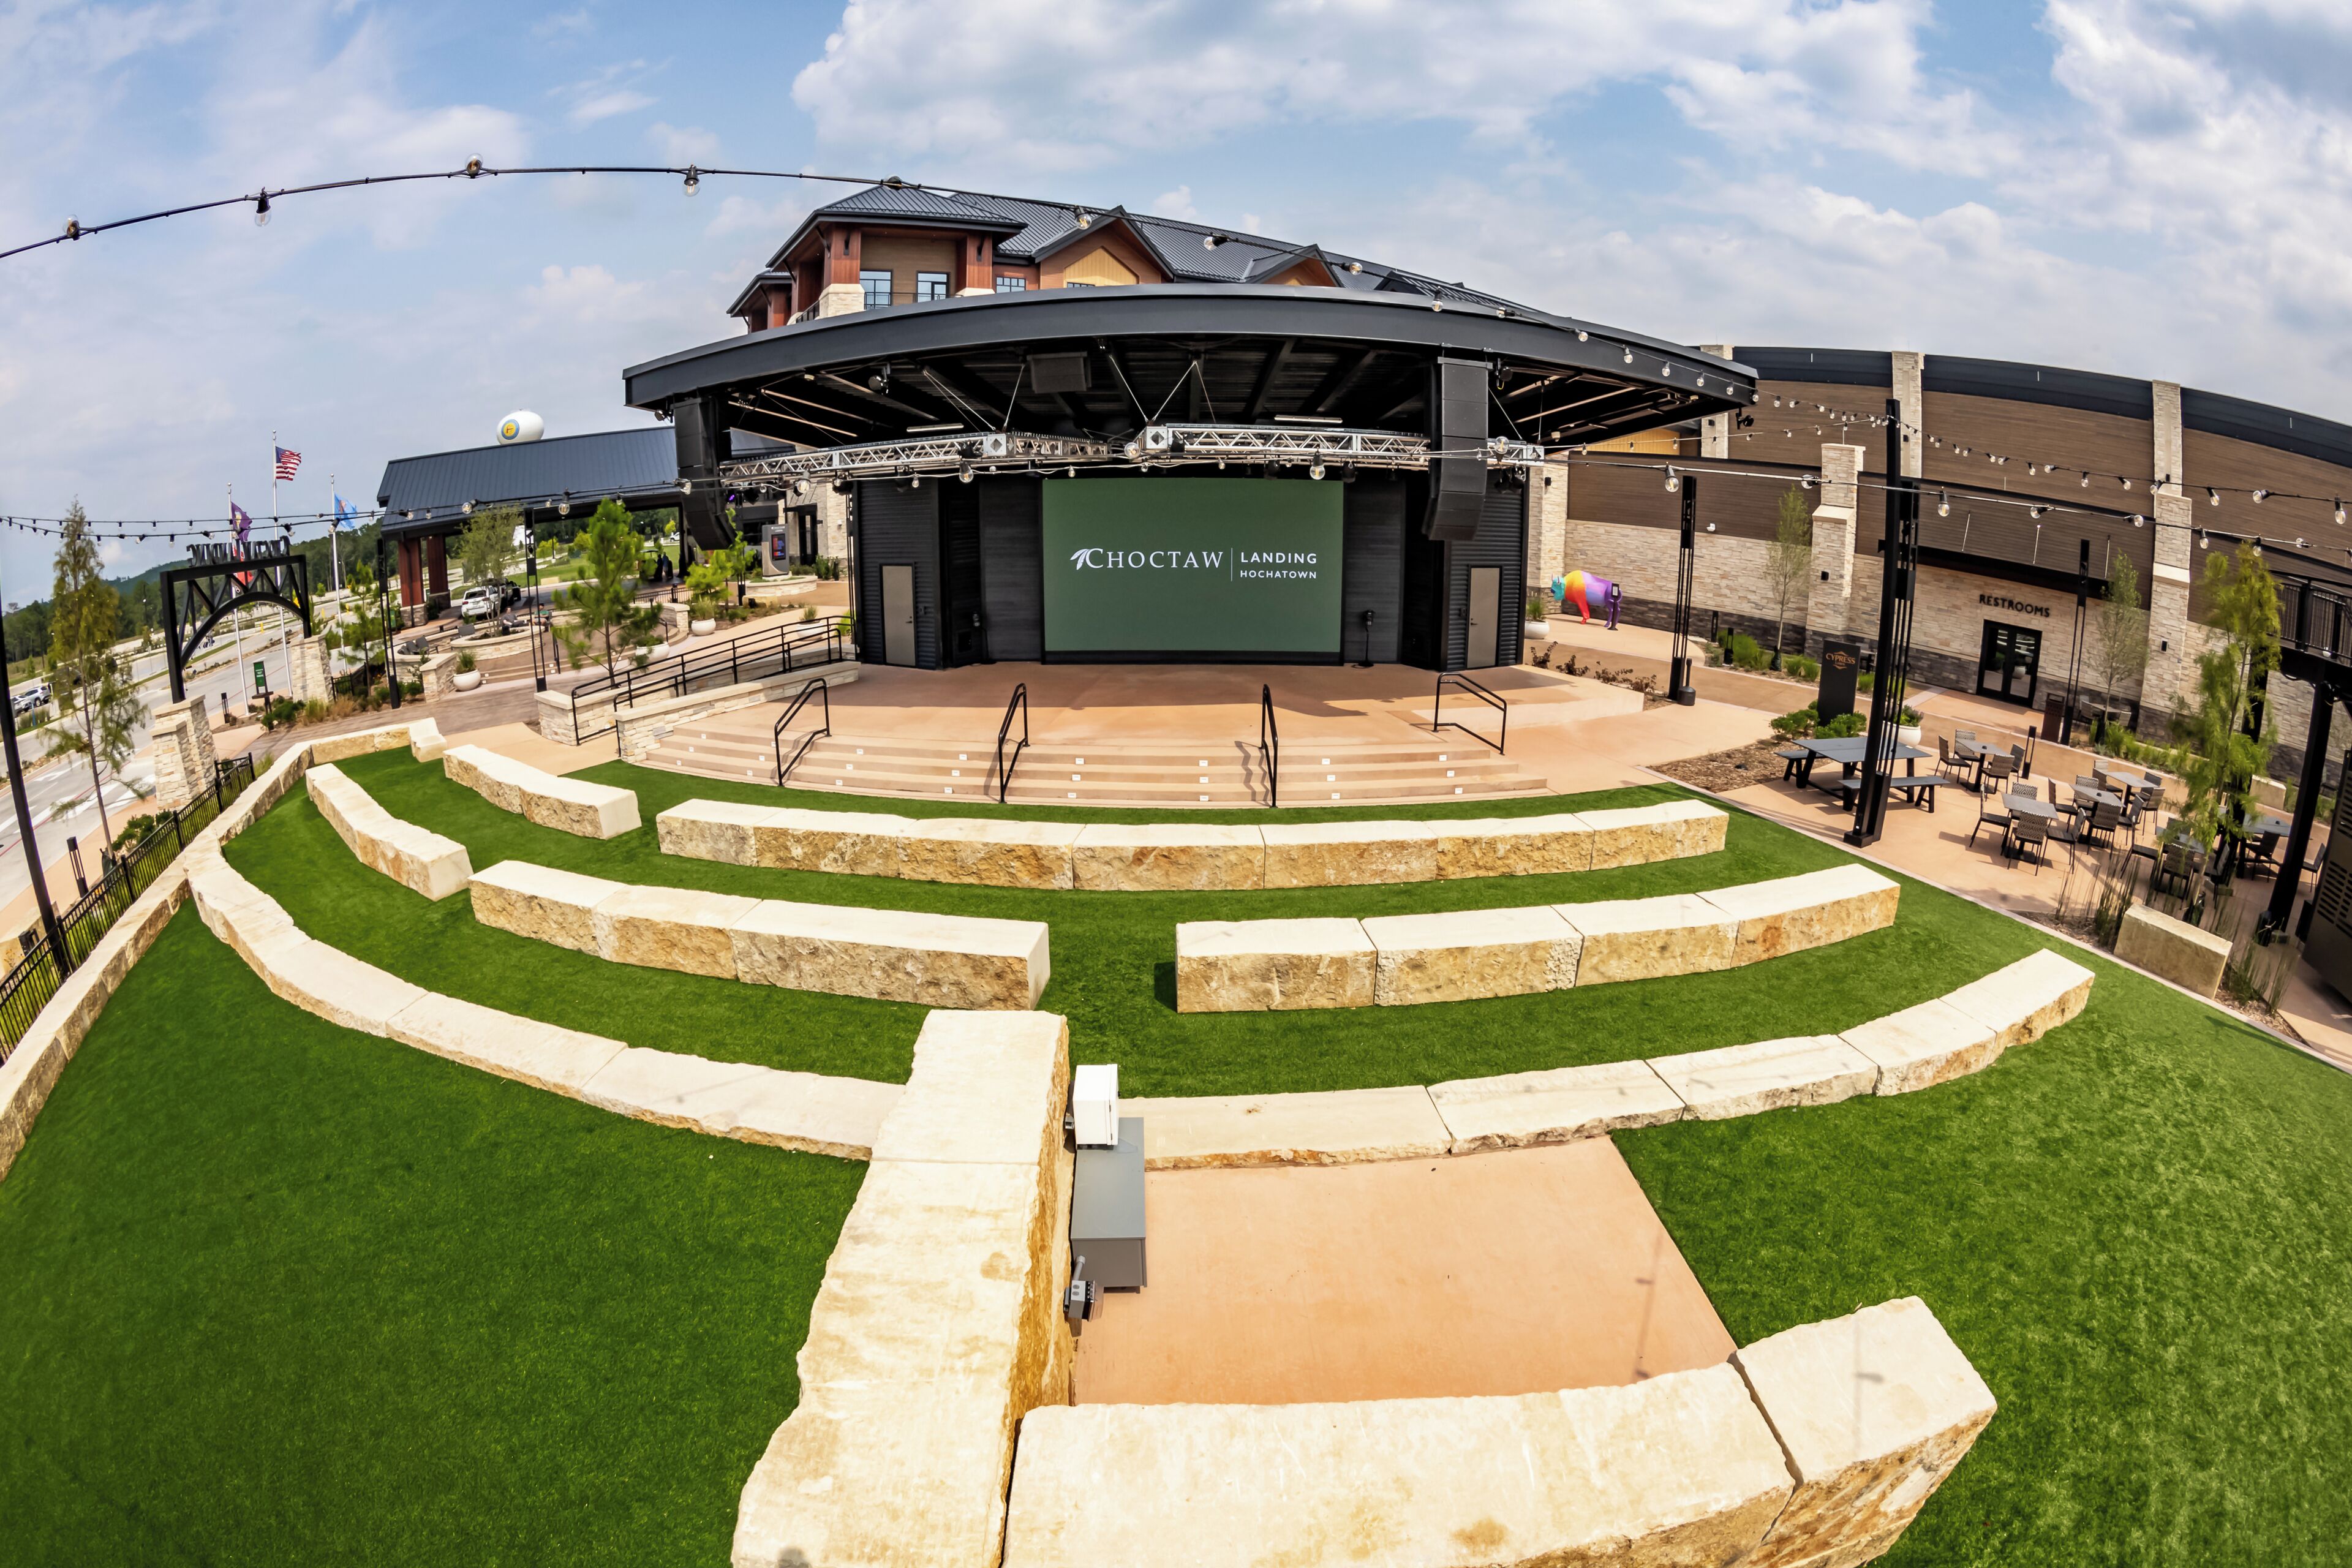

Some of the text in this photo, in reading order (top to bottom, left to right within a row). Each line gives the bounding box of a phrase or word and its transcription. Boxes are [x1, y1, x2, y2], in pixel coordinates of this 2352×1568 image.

[1085, 548, 1317, 568] CHOCTAW LANDING
[1240, 570, 1317, 579] HOCHATOWN
[1979, 594, 2050, 617] RESTROOMS
[1825, 653, 1855, 665] CYPRESS
